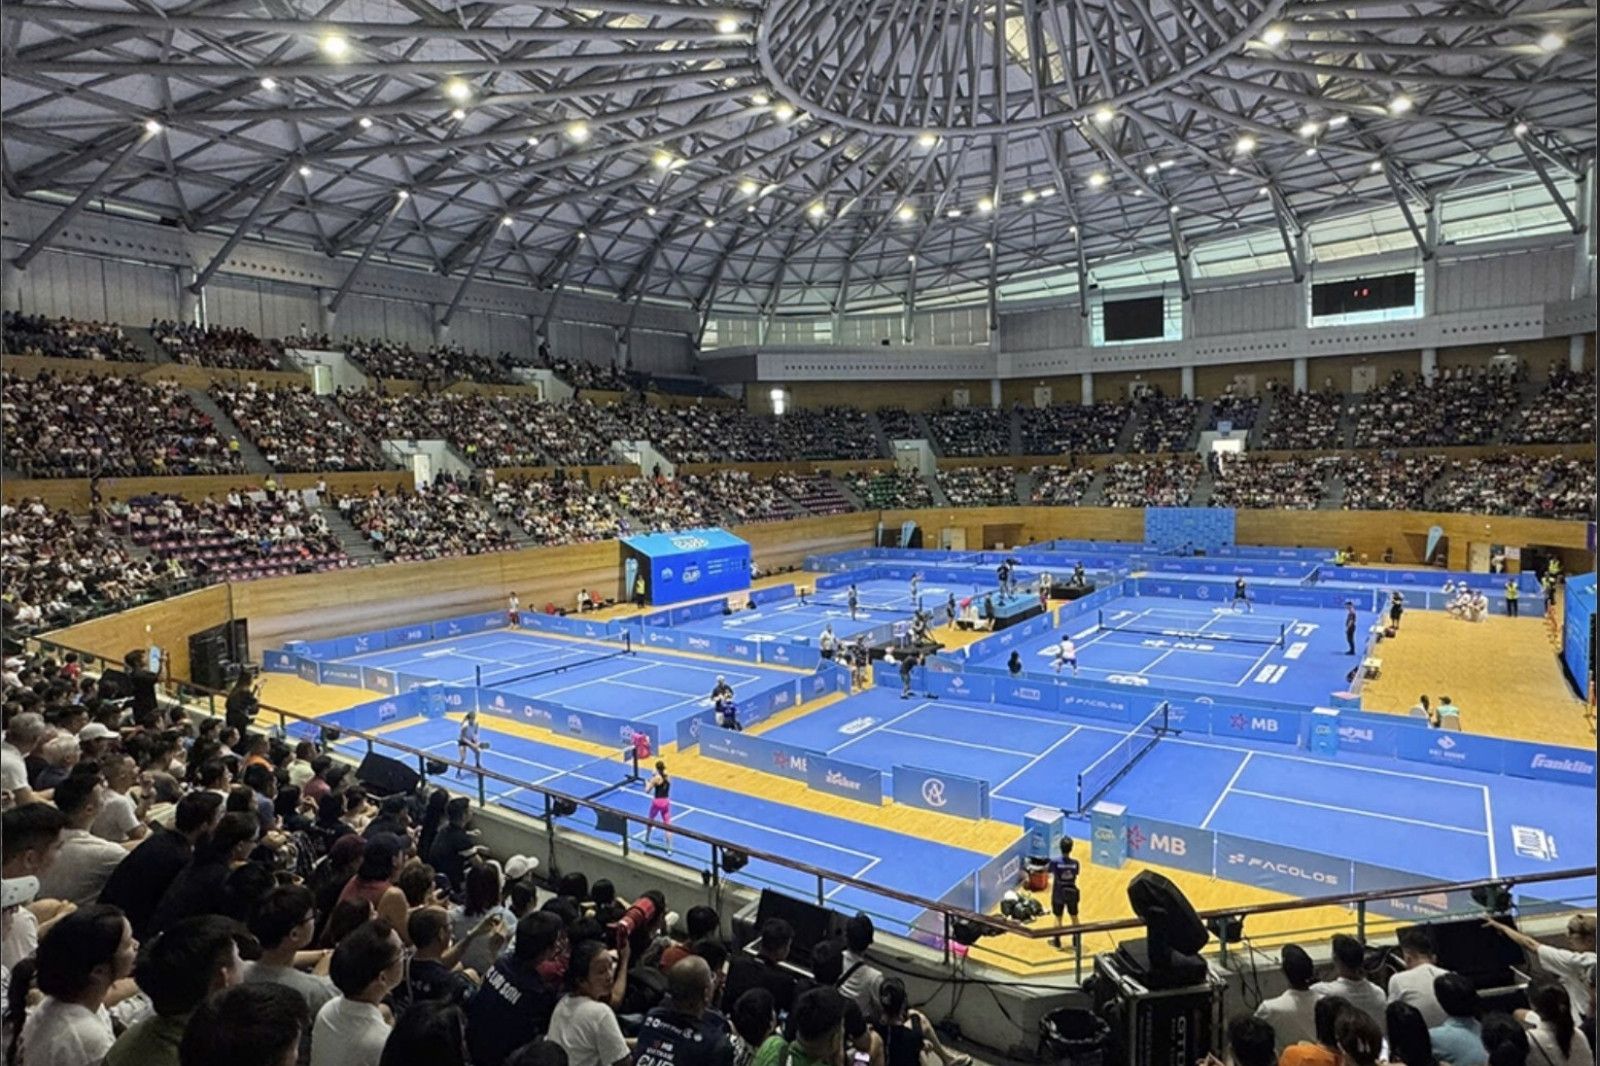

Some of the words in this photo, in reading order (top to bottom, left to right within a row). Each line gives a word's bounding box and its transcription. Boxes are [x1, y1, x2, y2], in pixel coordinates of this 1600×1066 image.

[1251, 717, 1279, 732] MB
[1530, 753, 1595, 775] Franklin
[1150, 832, 1188, 856] MB
[1247, 857, 1340, 886] FACOLOS
